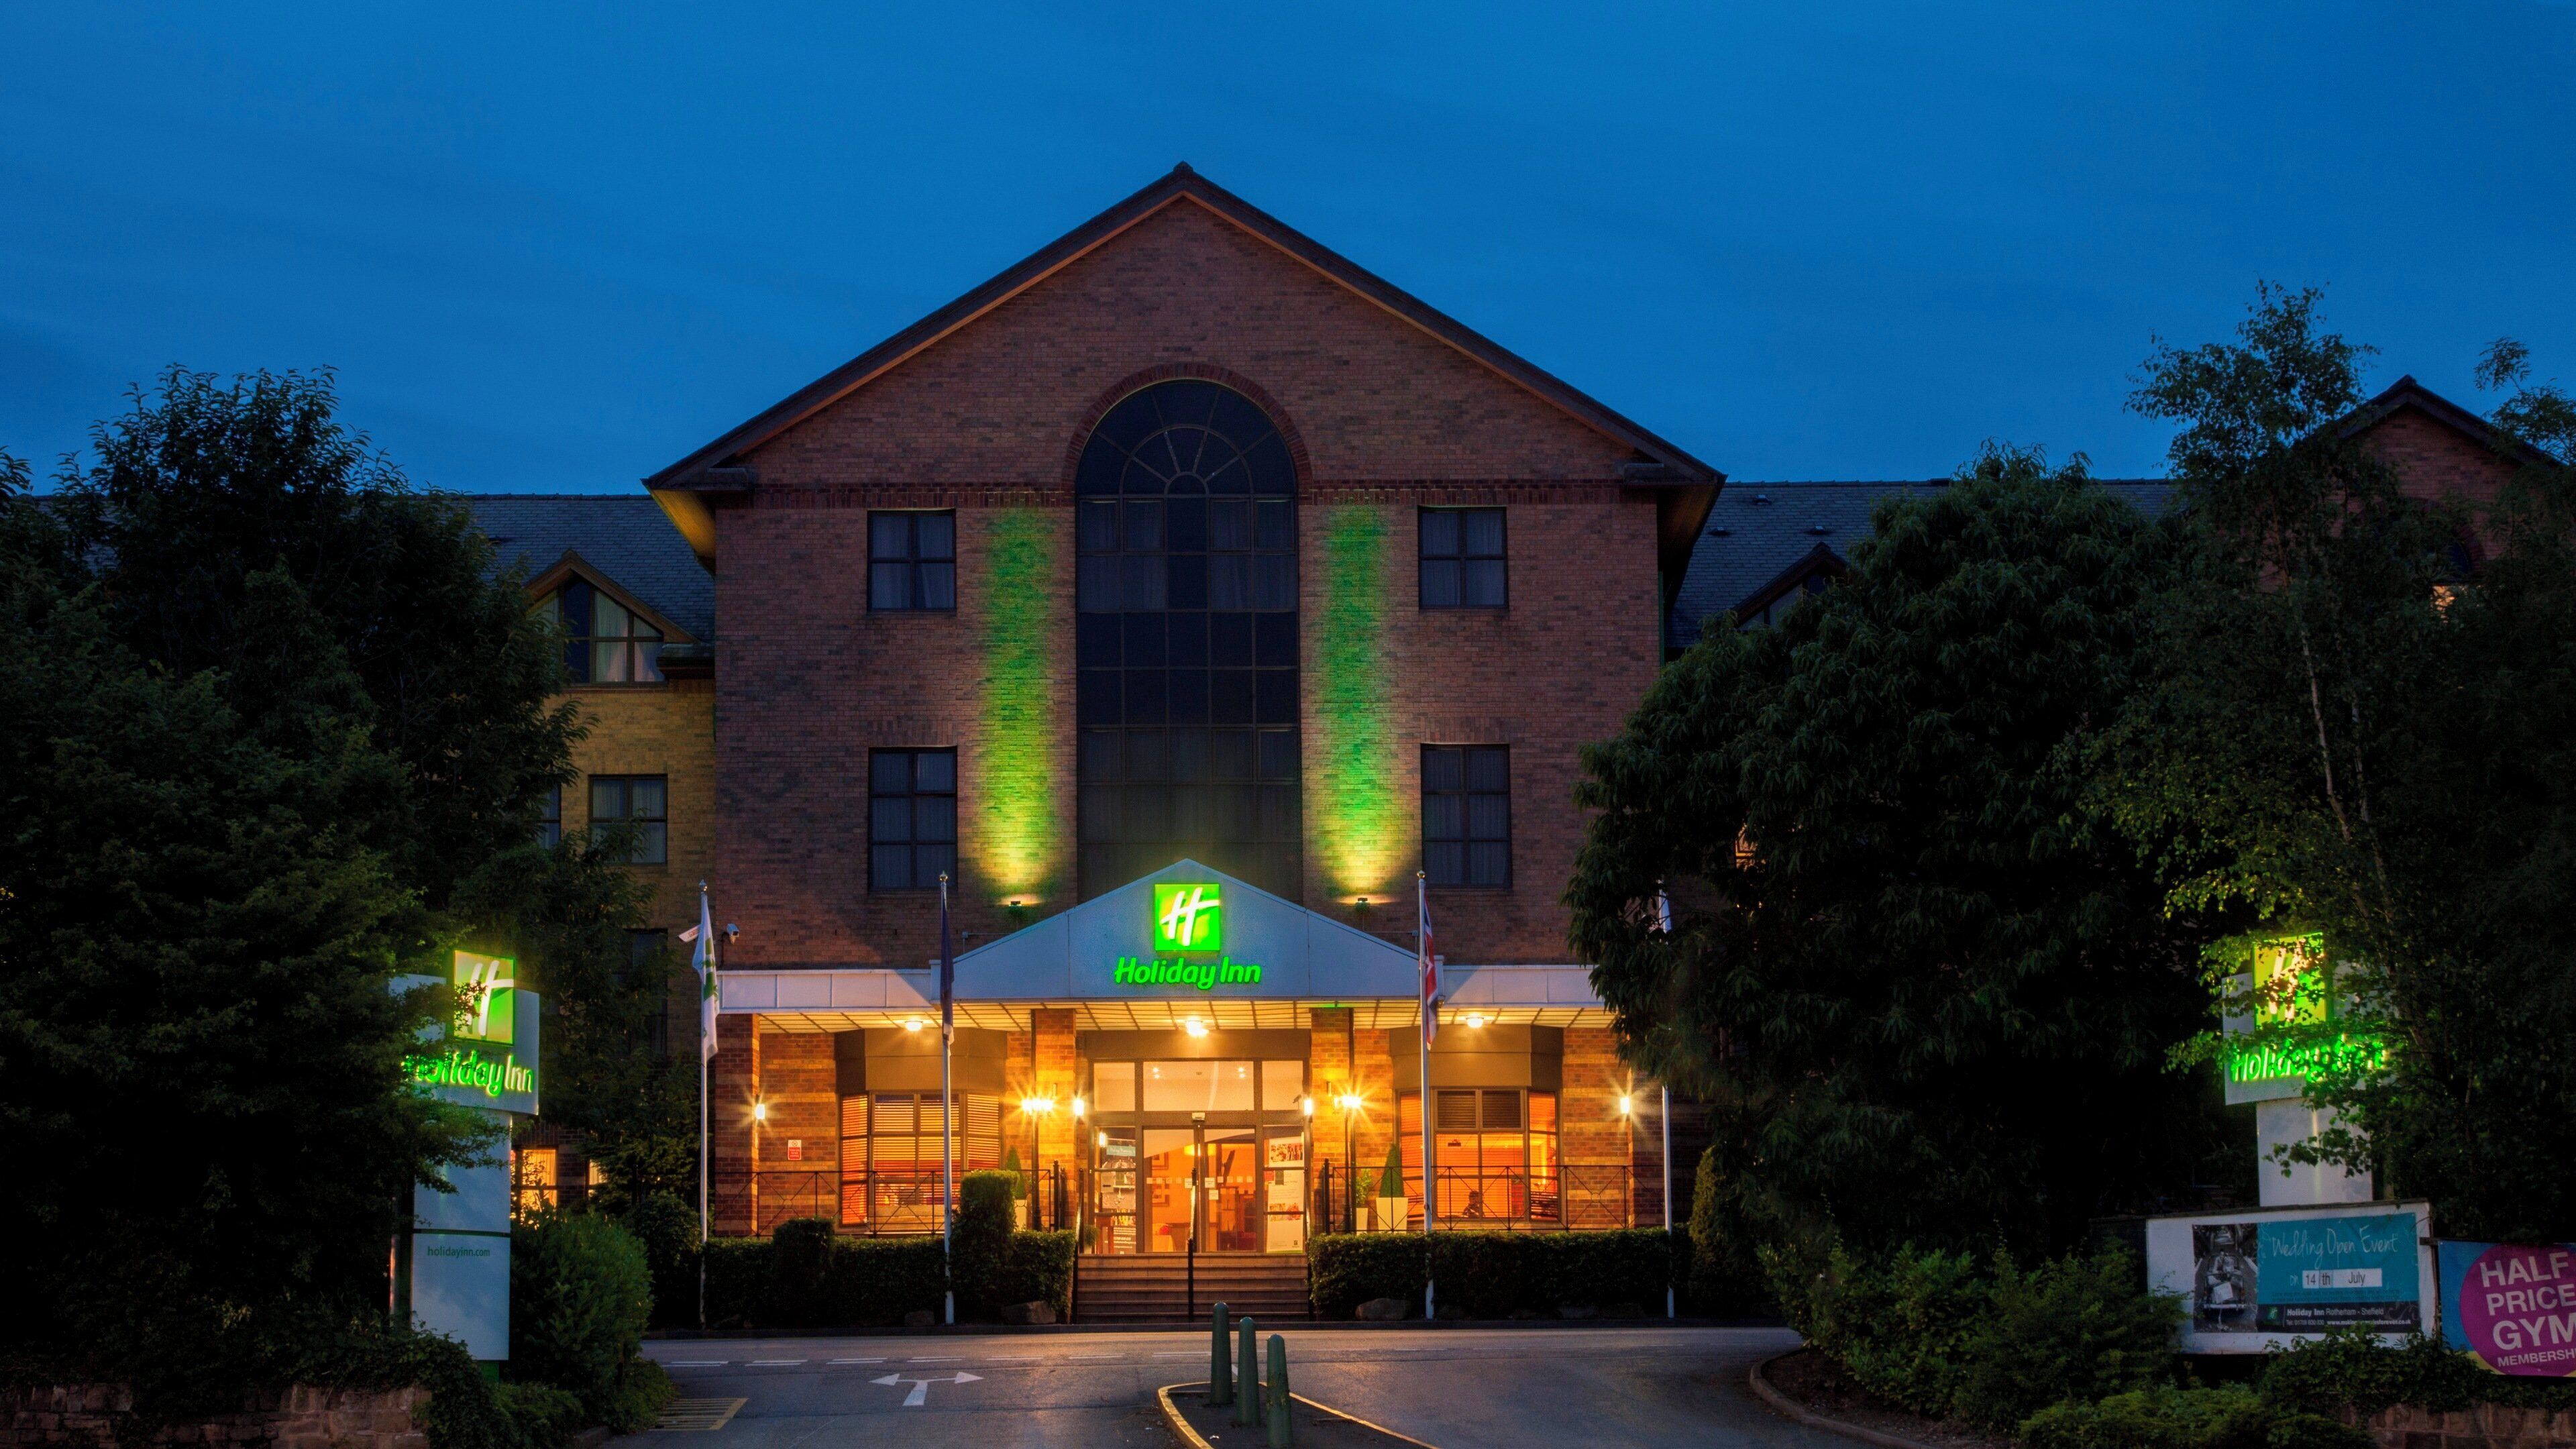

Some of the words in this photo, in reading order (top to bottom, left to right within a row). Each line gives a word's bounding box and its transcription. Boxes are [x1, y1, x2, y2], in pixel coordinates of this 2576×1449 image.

[1114, 957, 1216, 989] Holiday
[1220, 956, 1261, 983] Inn
[505, 1053, 533, 1093] Inn
[427, 1246, 490, 1258] holidayinn.com
[2272, 1230, 2324, 1269] Wedding
[2326, 1228, 2356, 1267] Open
[2359, 1225, 2399, 1253] Event
[2306, 1274, 2316, 1285] 14
[2322, 1273, 2330, 1285] th
[2349, 1272, 2365, 1286] July
[2479, 1251, 2569, 1288] HALF
[2287, 1308, 2312, 1318] Holiday
[2326, 1307, 2356, 1316] Rotherham
[2361, 1307, 2383, 1316] Sheffield
[2485, 1283, 2576, 1316] PRICE
[2493, 1312, 2576, 1350] GYM
